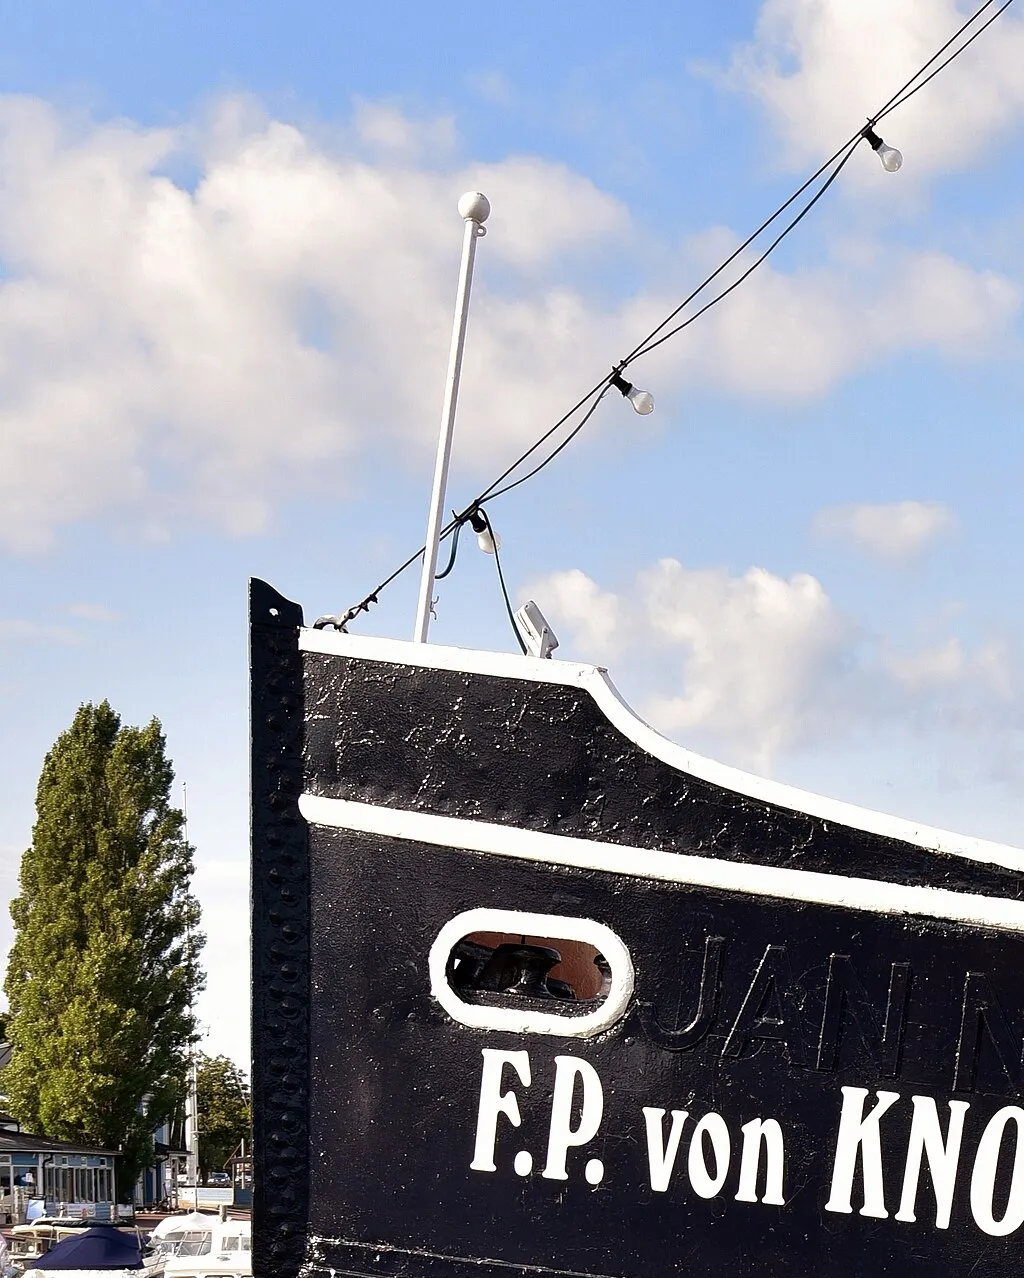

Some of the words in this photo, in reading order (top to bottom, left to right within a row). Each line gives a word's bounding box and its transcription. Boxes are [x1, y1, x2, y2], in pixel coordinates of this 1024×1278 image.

[636, 934, 912, 1079] JAN
[470, 1048, 605, 1185] F.P.
[642, 1107, 786, 1206] von
